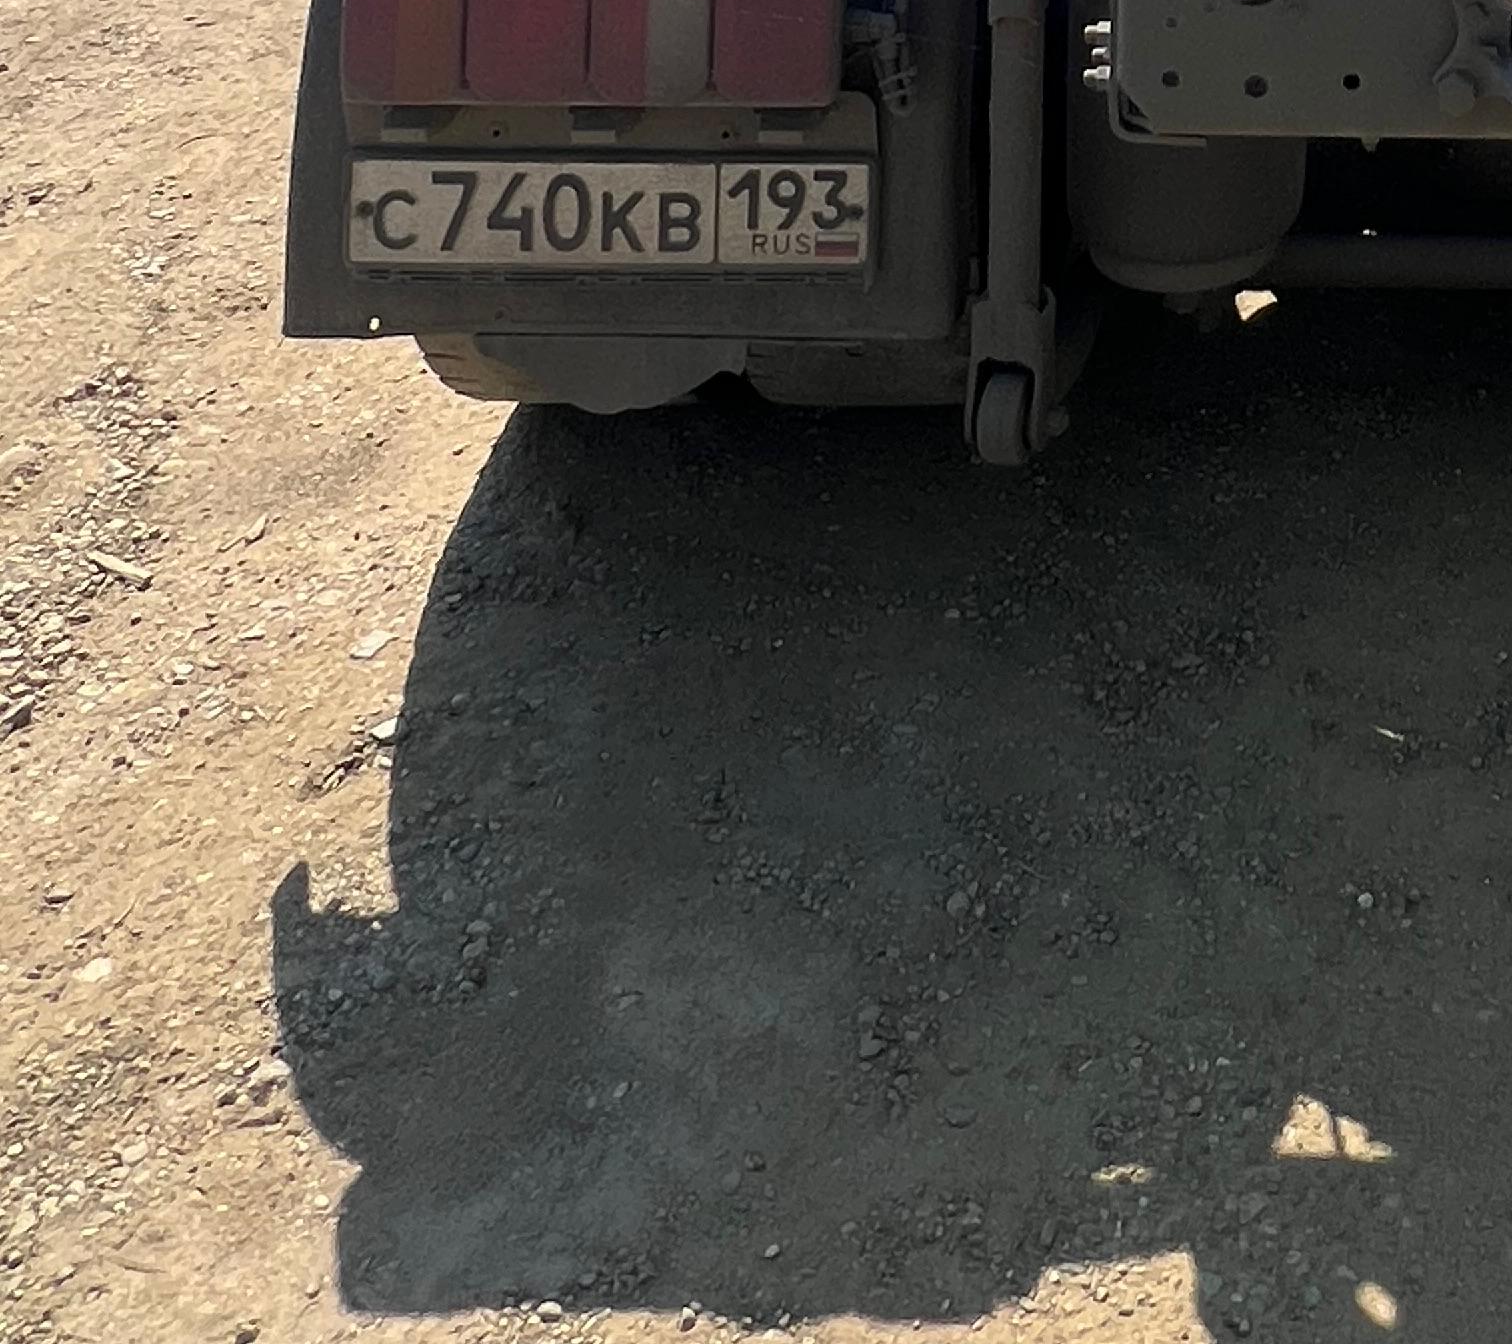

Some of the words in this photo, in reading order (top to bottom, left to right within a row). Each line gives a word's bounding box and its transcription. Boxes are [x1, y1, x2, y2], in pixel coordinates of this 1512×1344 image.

[372, 171, 701, 252] С740КВ
[727, 169, 850, 230] 193
[751, 234, 812, 255] RUS
